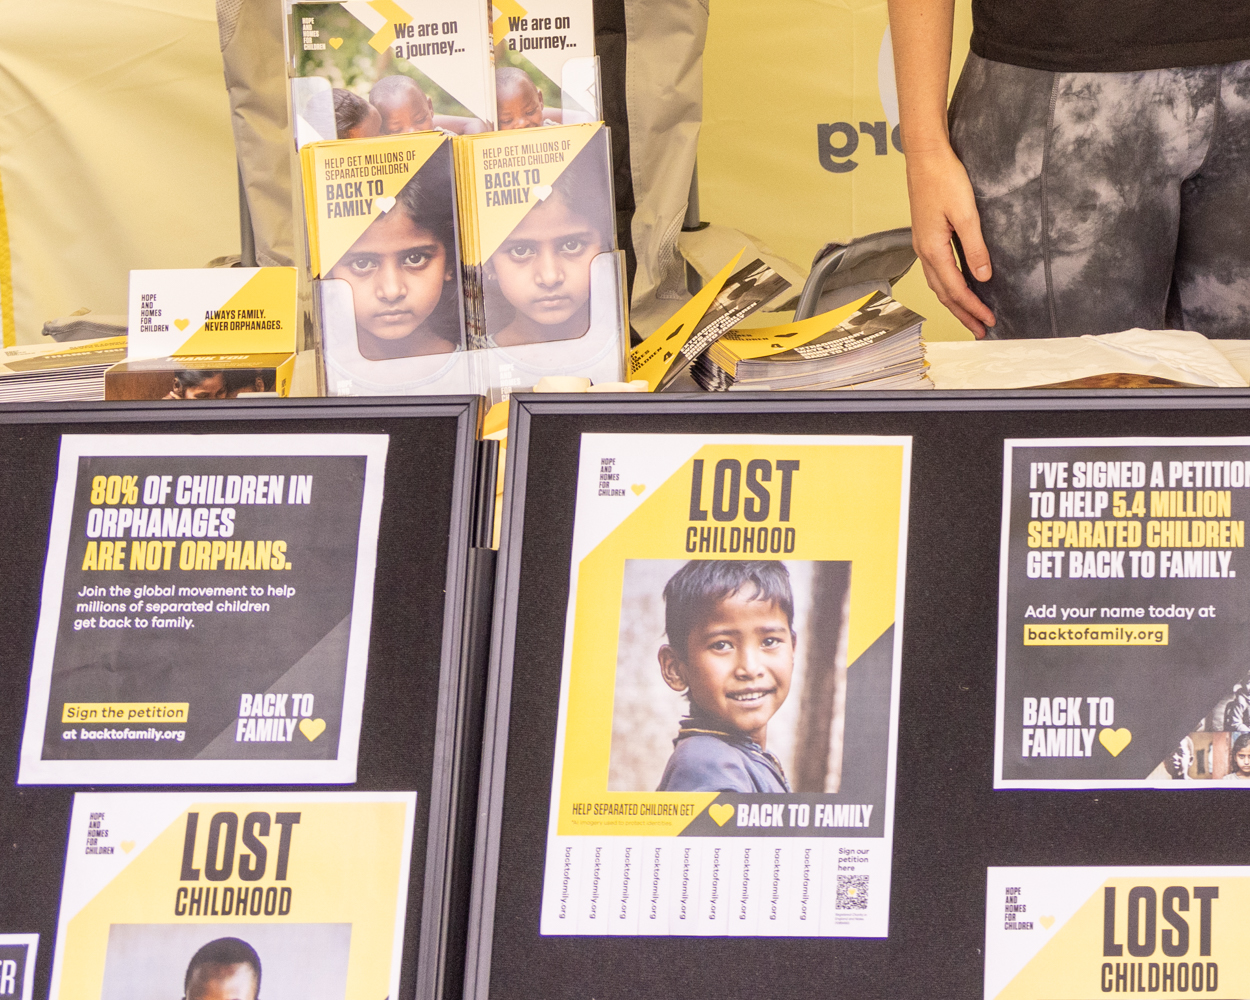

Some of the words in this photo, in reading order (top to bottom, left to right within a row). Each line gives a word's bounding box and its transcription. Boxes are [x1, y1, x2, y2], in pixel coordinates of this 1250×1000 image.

[394, 23, 414, 39] We
[418, 22, 439, 37] are
[442, 20, 457, 35] on
[396, 45, 404, 58] a
[406, 40, 465, 60] journey...
[325, 158, 345, 169] HELP
[347, 156, 362, 167] GET
[365, 152, 404, 166] MILLIONS
[406, 151, 416, 161] OF
[325, 167, 369, 180] SEPARATED
[371, 163, 409, 175] CHILDREN
[326, 181, 363, 200] BACK
[367, 179, 383, 195] TO
[327, 199, 373, 219] FAMILY
[205, 310, 235, 320] ALWAYS
[238, 310, 265, 319] FAMILY.
[205, 321, 228, 331] NEVER
[230, 321, 283, 330] ORPHANAGES.
[1030, 462, 1068, 488] I'VE
[1073, 462, 1145, 488] SIGNED
[1150, 462, 1164, 488] A
[91, 476, 138, 505] 80%
[143, 476, 172, 505] OF
[176, 475, 283, 504] CHILDREN
[289, 475, 312, 503] IN
[689, 459, 800, 522] LOST
[1030, 492, 1054, 518] TO
[1060, 492, 1108, 518] HELP
[1112, 491, 1146, 517] 5.4
[1151, 491, 1231, 517] MILLION
[86, 508, 235, 537] ORPHANAGES
[686, 526, 795, 553] CHILDHOOD
[1028, 521, 1142, 548] SEPARATED
[1147, 521, 1244, 547] CHILDREN
[82, 541, 126, 570] ARE
[130, 541, 176, 570] NOT
[179, 540, 291, 570] ORPHANS.
[1027, 551, 1064, 578] GET
[1069, 551, 1124, 578] BACK
[1130, 551, 1155, 578] TO
[1160, 551, 1236, 578] FAMILY.
[1025, 605, 1056, 618] Add
[1061, 606, 1096, 620] your
[1101, 607, 1144, 618] name
[1149, 605, 1194, 619] today
[1199, 606, 1215, 617] at
[1028, 628, 1164, 642] backtofamily.org
[67, 707, 98, 720] Sign
[102, 707, 124, 718] the
[128, 707, 184, 720] petition
[63, 729, 76, 740] at
[81, 728, 185, 741] backtofamily.org
[572, 804, 592, 815] HELP
[594, 804, 638, 816] SEPARATED
[640, 804, 678, 816] CHILDREN
[681, 804, 694, 816] GET
[180, 812, 301, 881] LOST
[838, 856, 869, 864] petition
[679, 848, 691, 920] backtofamily.org
[175, 887, 292, 916] CHILDHOOD
